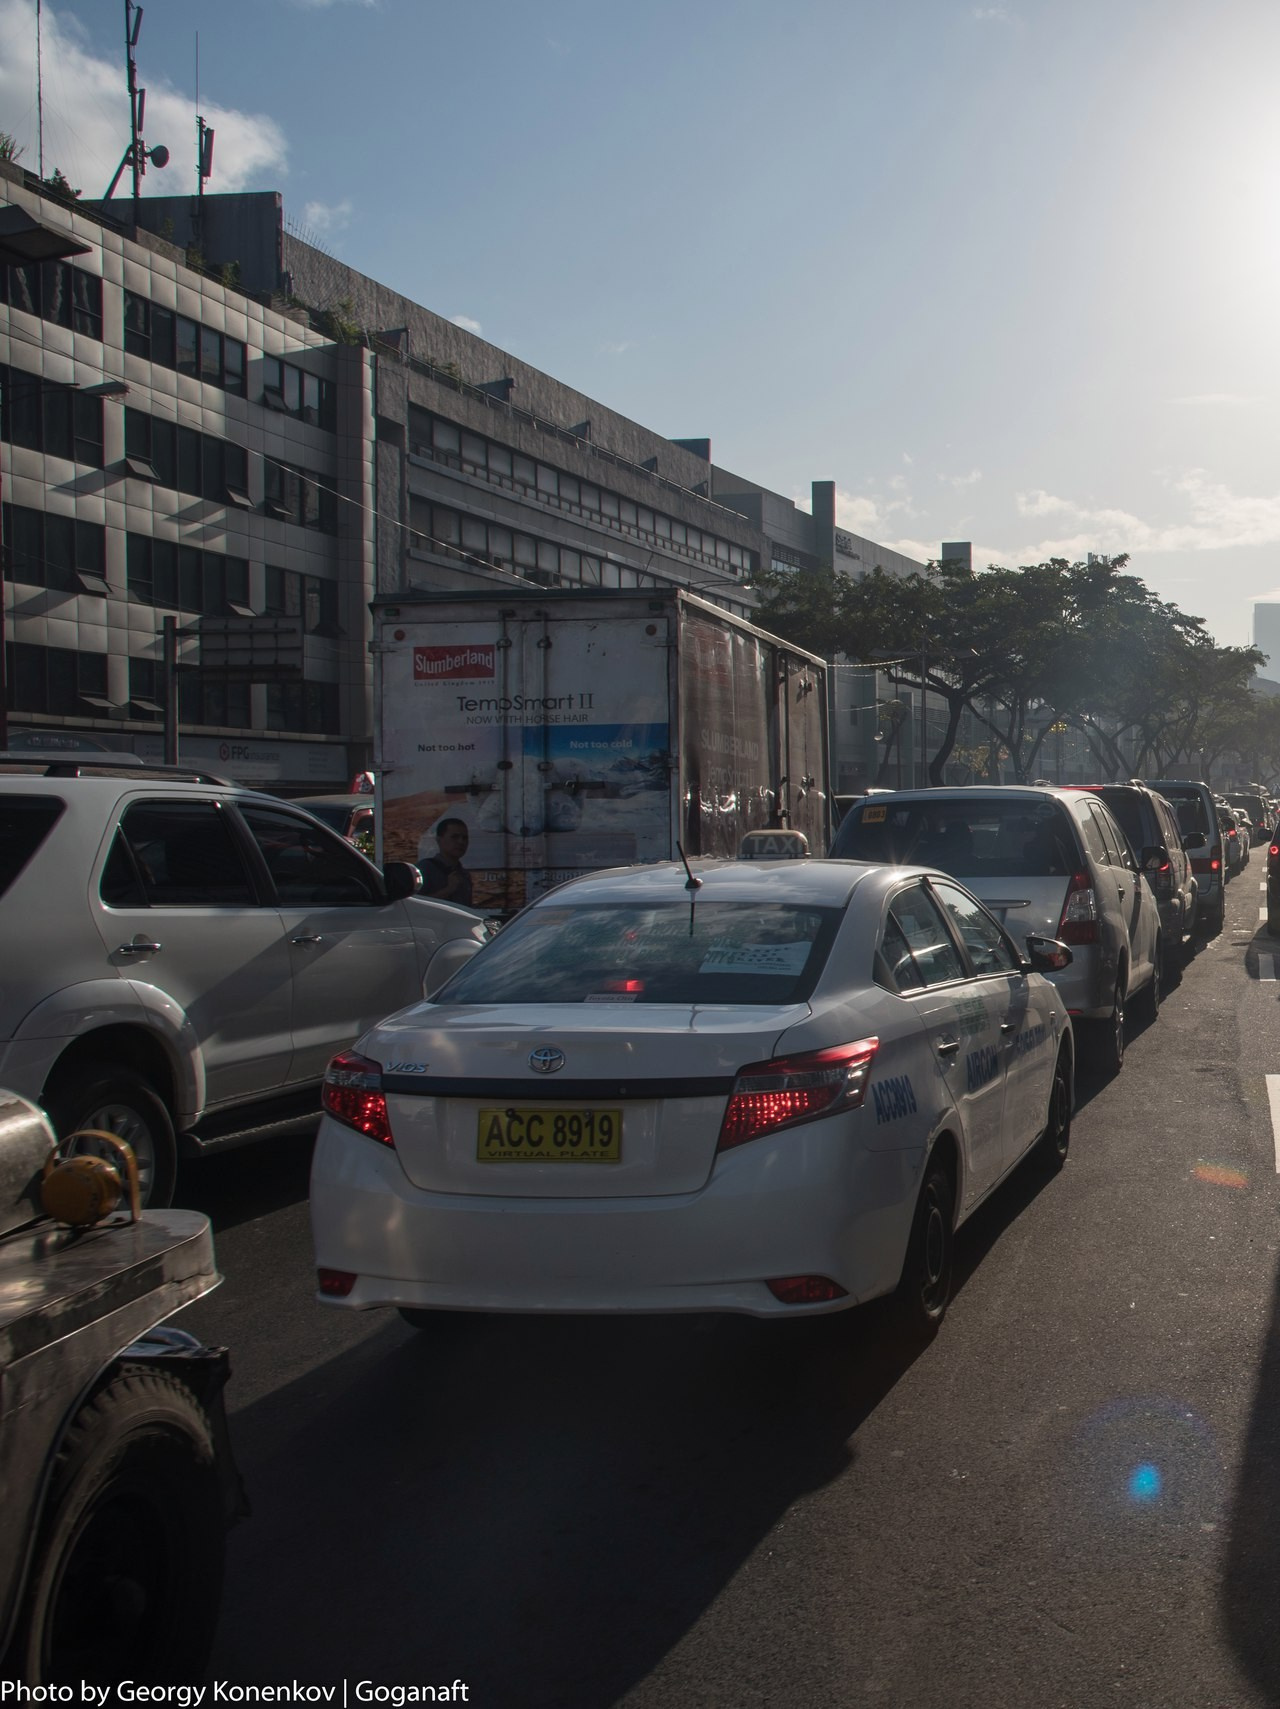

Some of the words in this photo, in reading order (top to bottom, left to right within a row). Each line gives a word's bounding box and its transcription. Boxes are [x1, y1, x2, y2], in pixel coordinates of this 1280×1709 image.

[415, 649, 493, 674] Slumberland
[456, 694, 574, 713] TempSmart
[578, 693, 595, 710] II
[466, 715, 493, 725] NOW
[495, 715, 521, 725] WITH
[525, 714, 561, 724] HORSE
[564, 713, 589, 723] HAIR
[232, 745, 249, 760] FPG
[418, 743, 435, 752] Not
[438, 743, 455, 751] too
[458, 743, 475, 752] hot
[570, 740, 588, 749] Not
[591, 740, 608, 749] too
[611, 739, 633, 749] cold
[701, 729, 759, 761] SLUMBERLAND
[750, 836, 803, 853] TAXI
[966, 1044, 1000, 1091] AIRCON
[485, 1113, 544, 1148] ACC
[553, 1113, 613, 1148] 8919
